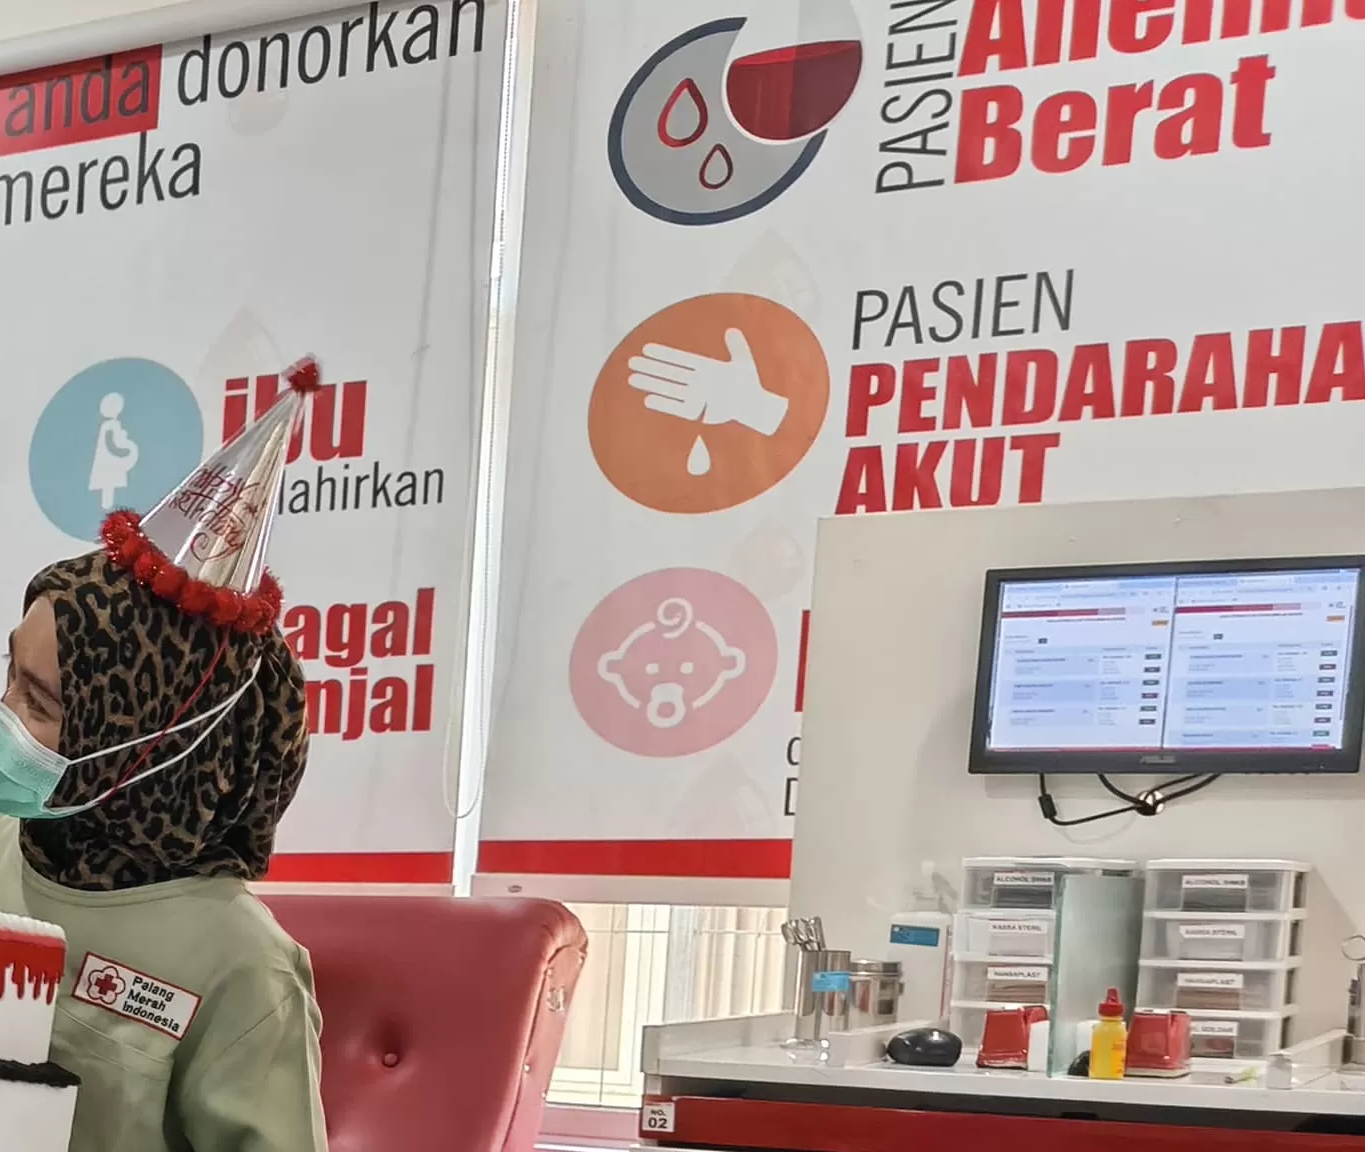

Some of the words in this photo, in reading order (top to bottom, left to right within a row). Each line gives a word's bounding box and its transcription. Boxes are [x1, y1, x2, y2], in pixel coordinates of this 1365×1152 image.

[5, 55, 150, 137] anda
[177, 0, 484, 107] donorkan
[957, 0, 1365, 76] Anem
[954, 54, 1276, 184] Berat
[852, 269, 1075, 350] PASIEN
[845, 320, 1365, 437] PENDARAHA
[277, 461, 444, 515] lahirkan
[835, 432, 1061, 515] AKUT
[283, 587, 436, 668] agal
[304, 663, 435, 741] njal
[122, 1000, 181, 1033] Indonesia
[127, 988, 166, 1012] Merah
[132, 975, 175, 1003] Palang
[648, 1117, 668, 1129] 02
